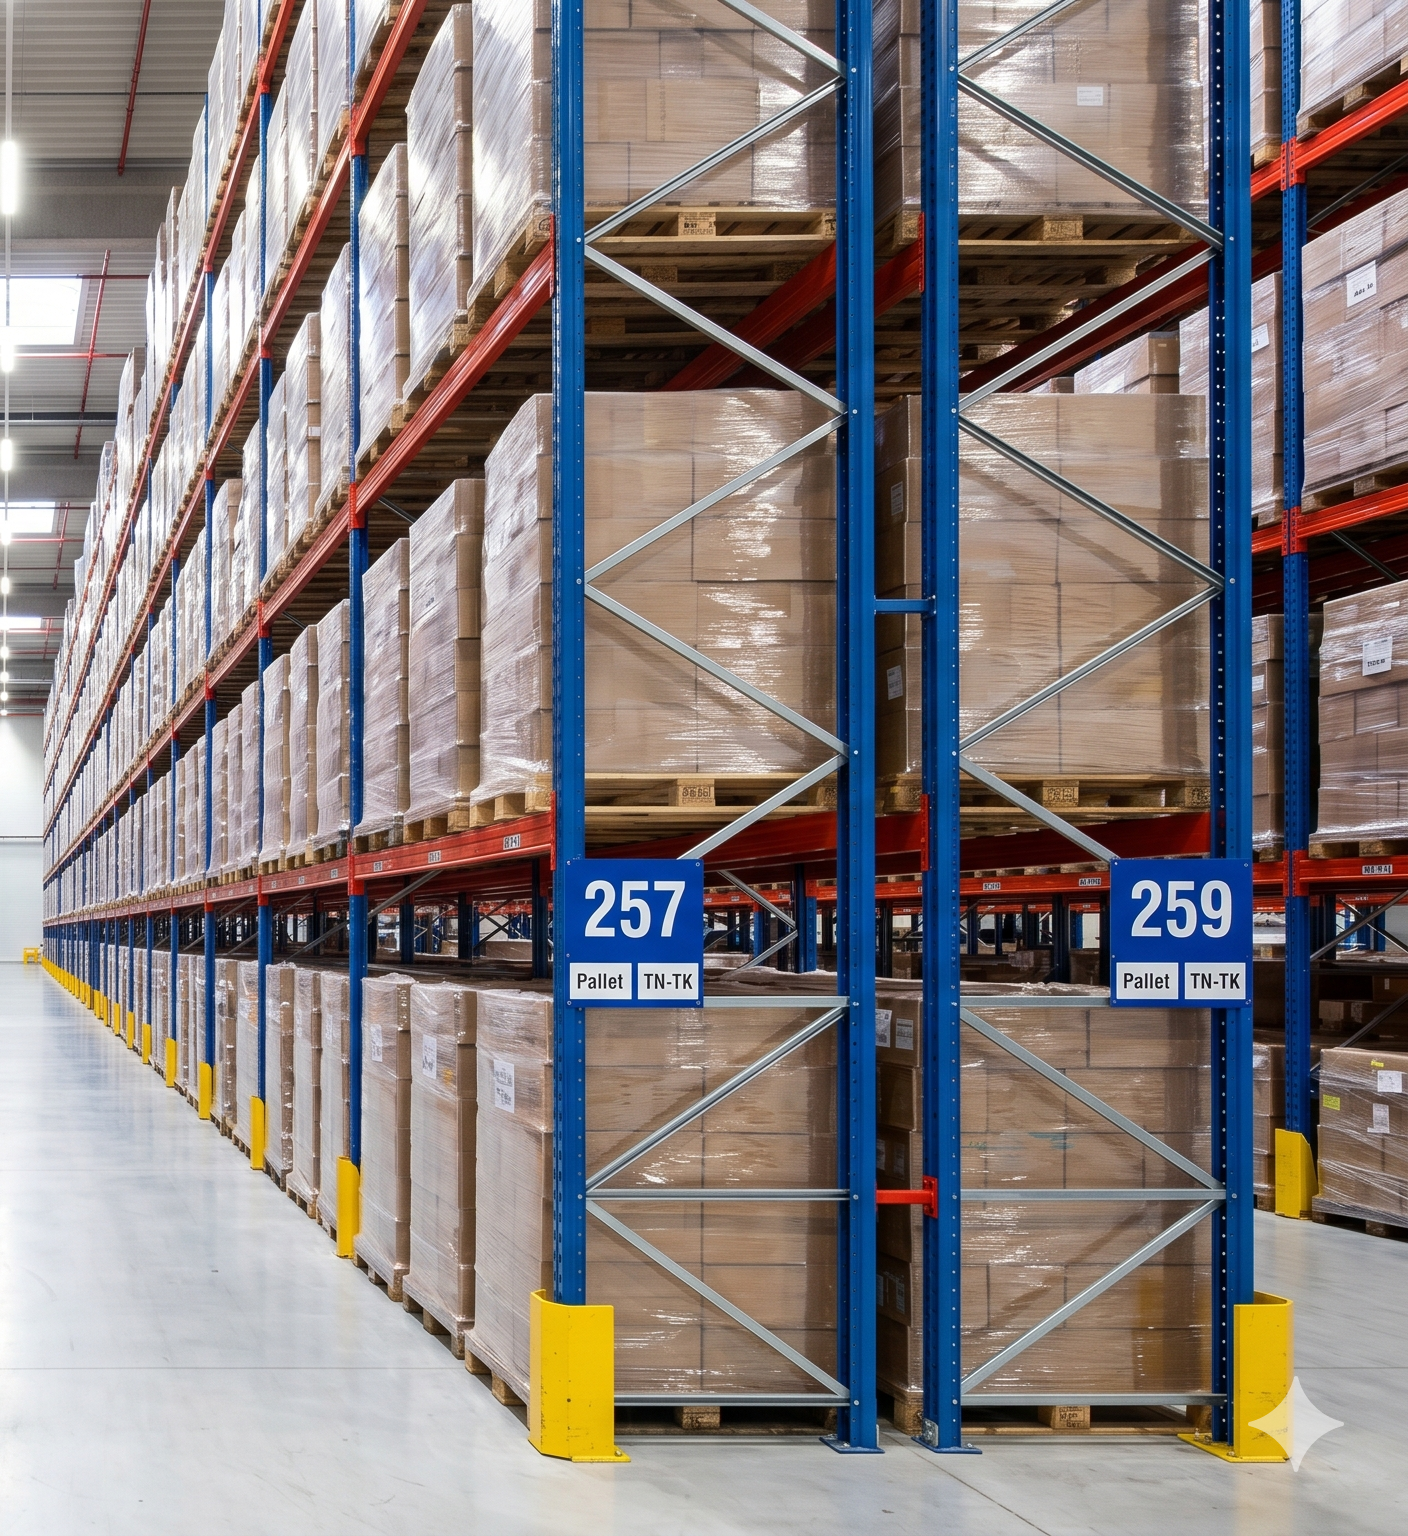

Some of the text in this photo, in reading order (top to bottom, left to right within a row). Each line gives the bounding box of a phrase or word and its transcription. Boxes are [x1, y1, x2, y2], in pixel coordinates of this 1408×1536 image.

[584, 879, 686, 939] 257
[1131, 879, 1232, 938] 259
[577, 973, 693, 990] Pallet TN-TK
[1123, 972, 1240, 990] Pallet TN-TK
